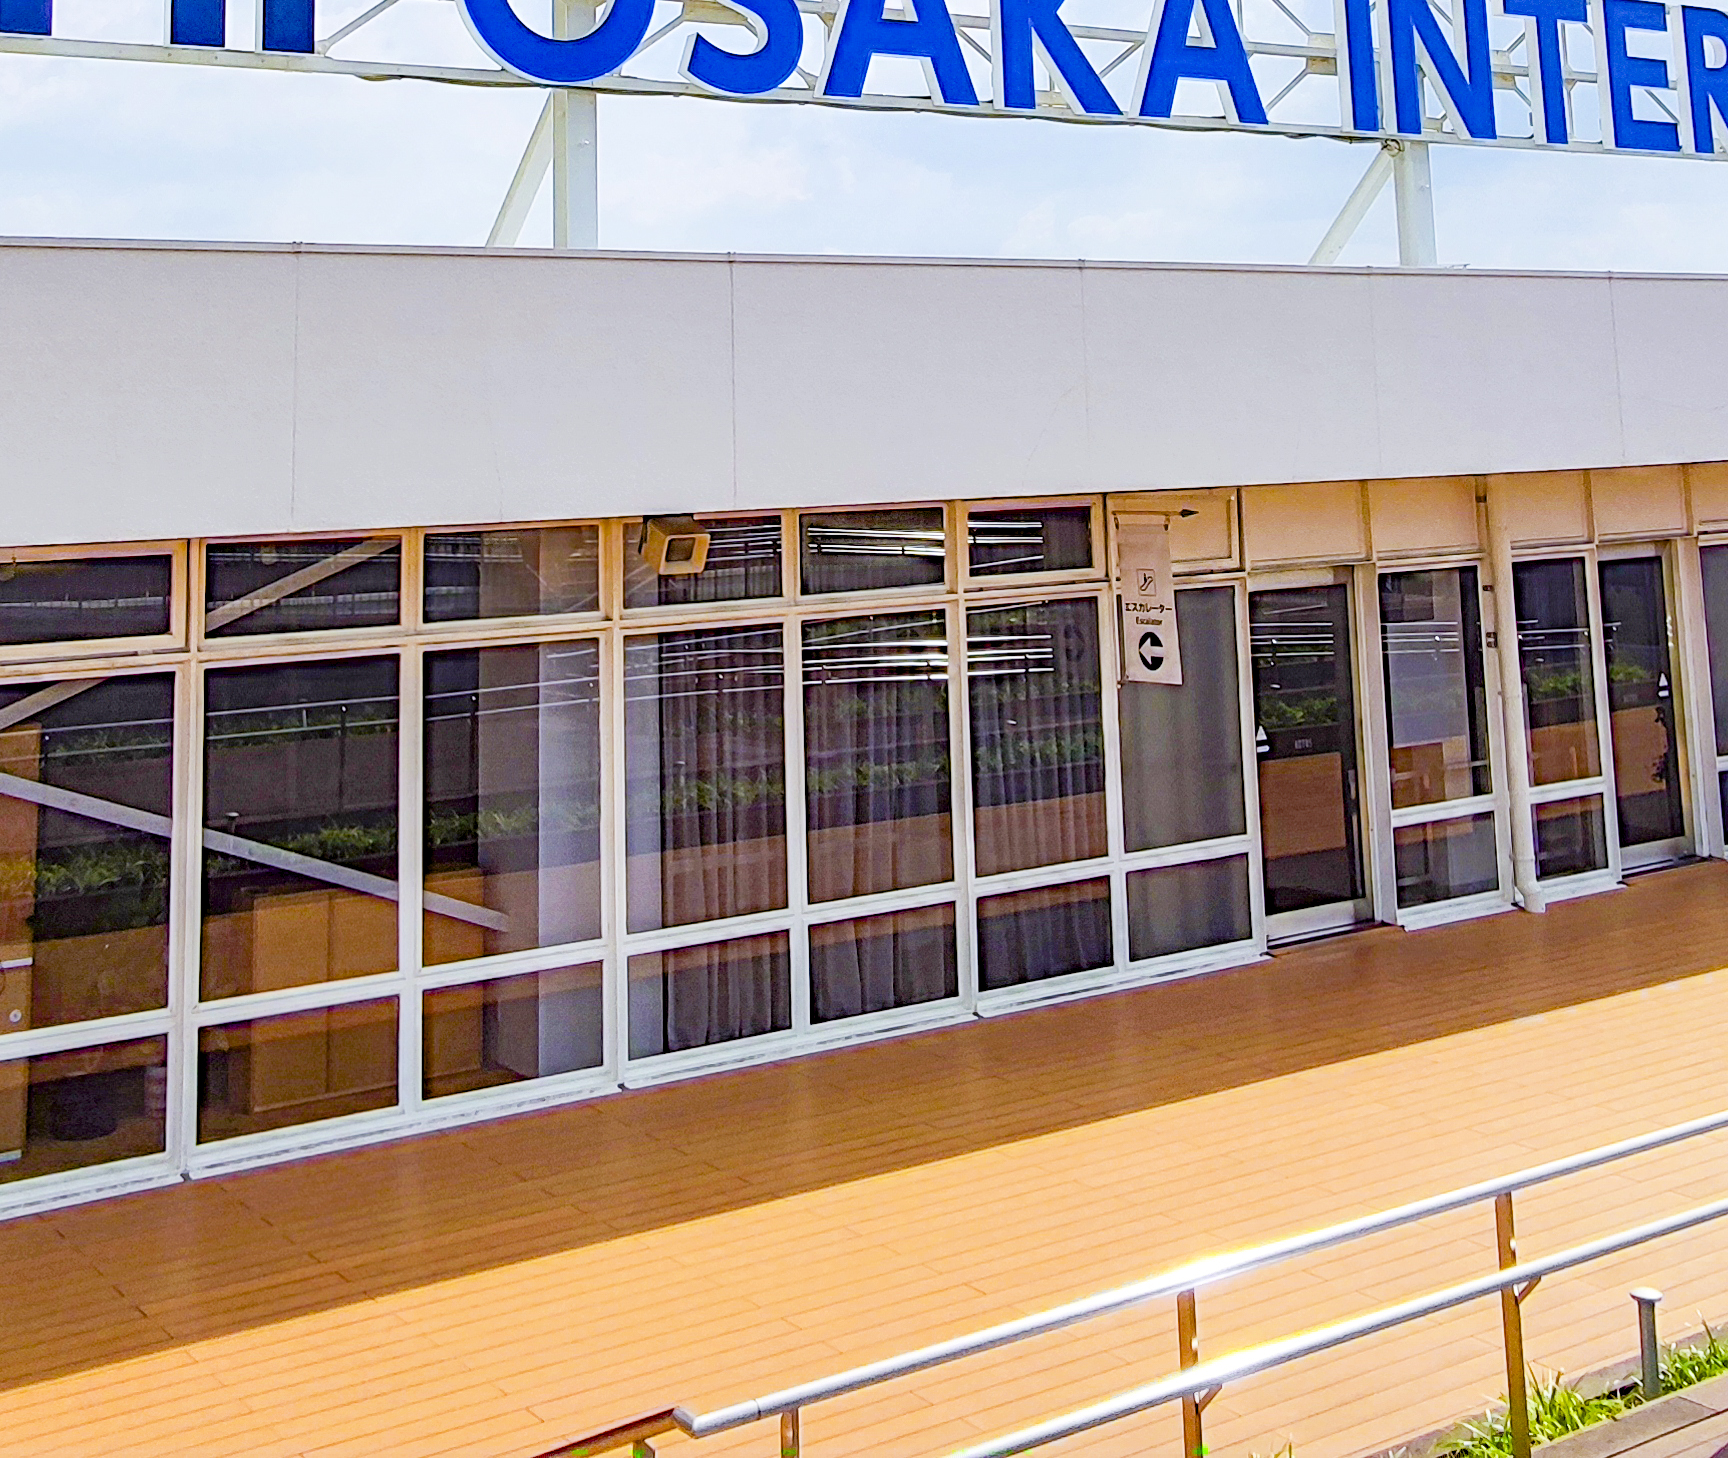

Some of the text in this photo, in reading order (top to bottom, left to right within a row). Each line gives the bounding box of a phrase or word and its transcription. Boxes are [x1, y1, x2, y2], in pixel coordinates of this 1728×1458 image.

[1125, 602, 1172, 613] エスカレーター
